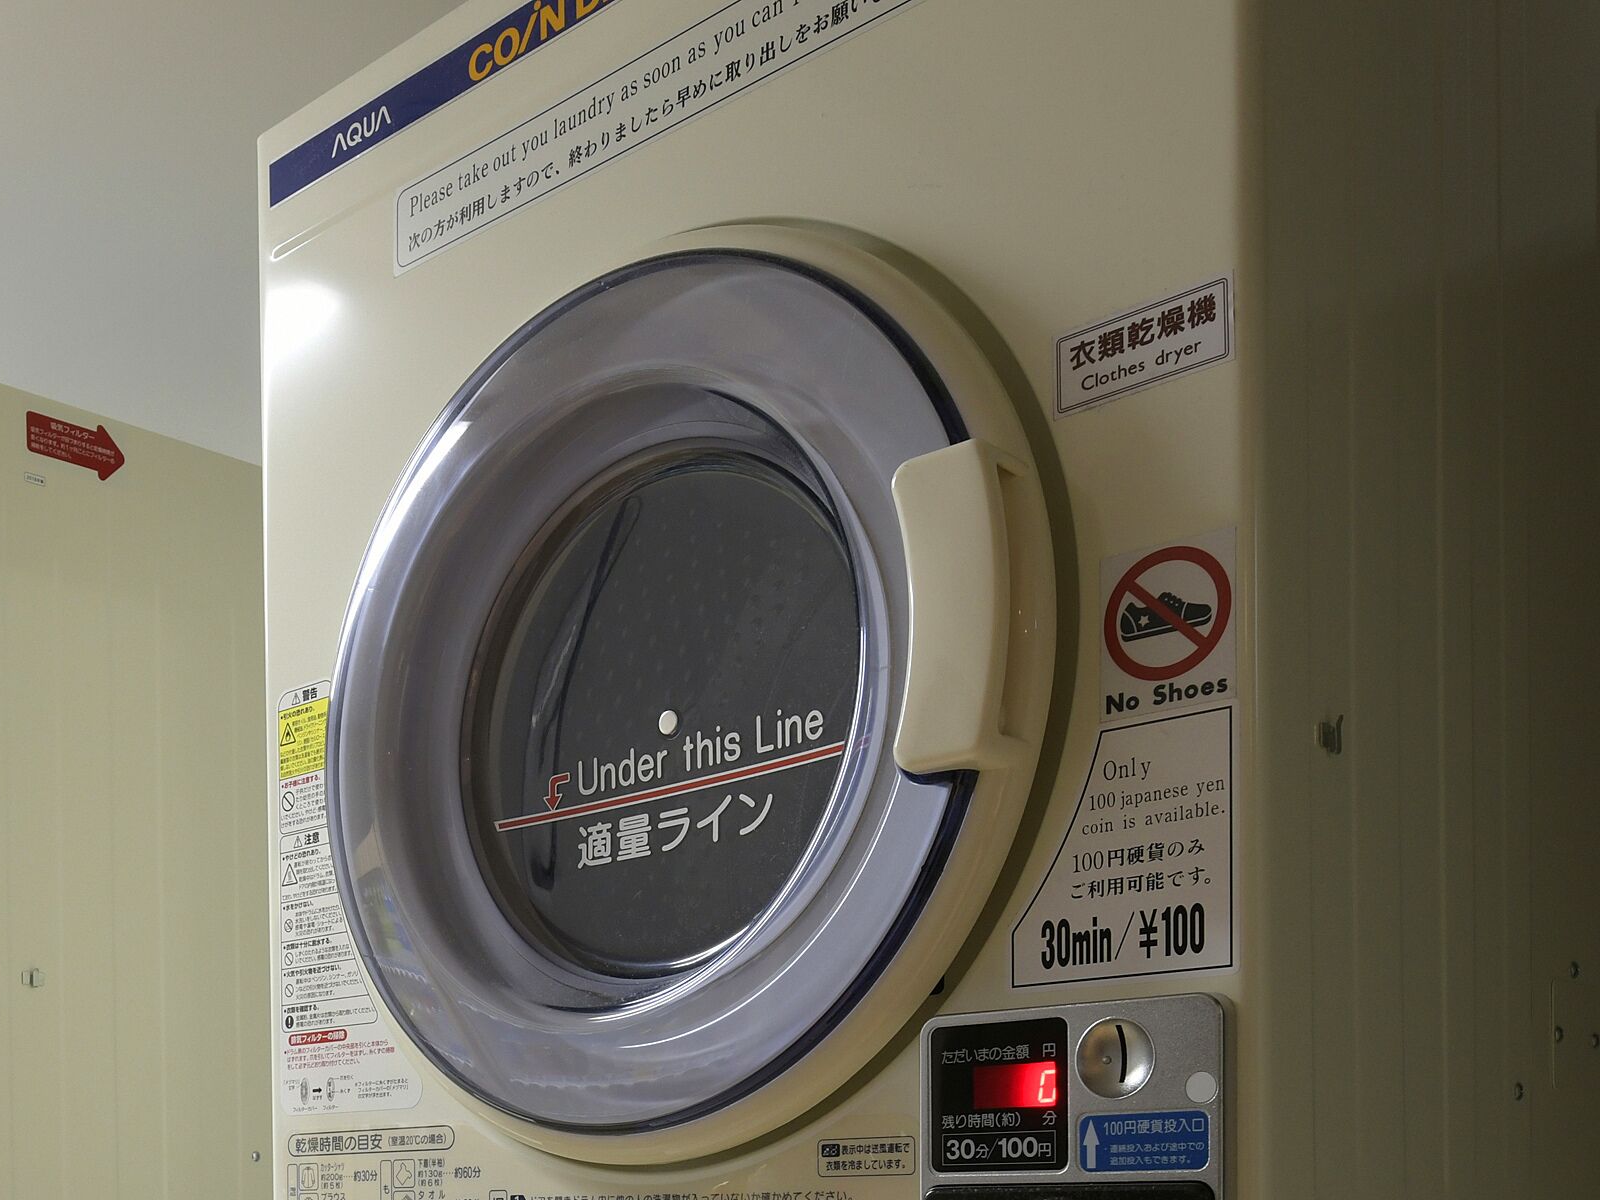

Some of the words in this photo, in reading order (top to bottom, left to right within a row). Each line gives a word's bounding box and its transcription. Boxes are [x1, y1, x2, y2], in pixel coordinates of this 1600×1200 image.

[468, 0, 566, 81] COIN
[408, 184, 454, 218] Please
[457, 163, 489, 193] take
[492, 143, 517, 173] out
[521, 128, 549, 161] you
[553, 90, 615, 141] laundry
[621, 77, 639, 103] as
[643, 56, 682, 89] soon
[688, 39, 706, 65] as
[713, 20, 745, 55] you
[751, 1, 784, 28] can
[331, 105, 391, 158] AQUA
[1068, 293, 1217, 371] 衣類乾燥機
[1081, 359, 1145, 390] Clothes
[1155, 340, 1201, 365] dryer
[1105, 692, 1140, 715] No
[1152, 678, 1229, 705] Shoes
[576, 746, 669, 796] Under
[682, 724, 742, 773] this
[755, 708, 825, 755] Line
[1102, 757, 1152, 781] Only
[1089, 791, 1116, 811] 100
[1120, 782, 1189, 810] japanese
[1196, 778, 1225, 797] yen
[576, 792, 774, 870] 適量ライン
[1082, 817, 1114, 836] coin
[1123, 814, 1136, 829] is
[1144, 801, 1226, 826] available.
[1072, 838, 1205, 874] 100円硬貨のみ
[1070, 866, 1212, 899] ご利用可能です。
[940, 1044, 1031, 1065] ただいまの金額
[1042, 1042, 1057, 1057] 円
[1042, 1110, 1058, 1126] 分
[1103, 1118, 1205, 1136] 100円硬貨投入口
[295, 1134, 383, 1153] 乾燥時間の目安
[946, 1136, 1053, 1160] 30分/100円
[353, 1170, 378, 1182] 約30分
[454, 1167, 482, 1179] 約60分
[826, 1158, 906, 1172] 衣類を冷ましています。
[1109, 1155, 1191, 1166] 追加投入もできます。
